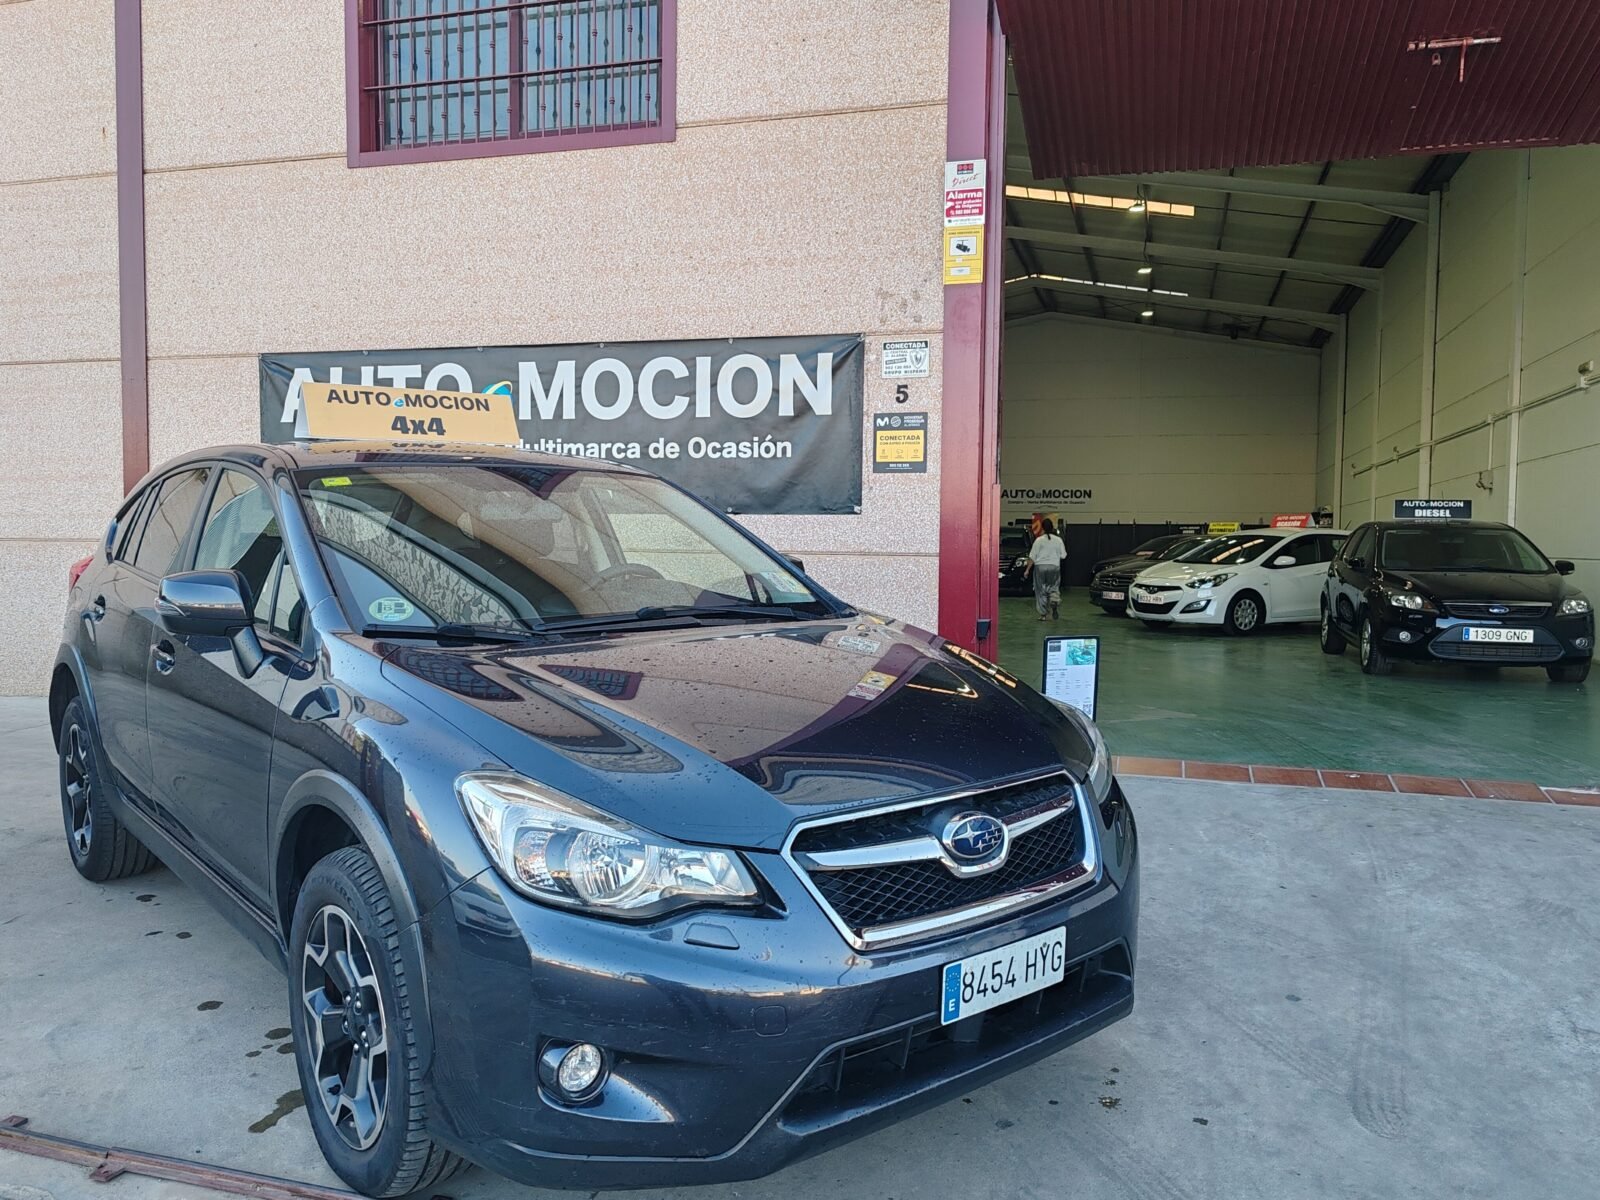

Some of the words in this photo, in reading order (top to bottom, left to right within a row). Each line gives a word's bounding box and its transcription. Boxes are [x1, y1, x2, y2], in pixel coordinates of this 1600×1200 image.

[947, 191, 983, 200] Alarma
[885, 342, 926, 350] CONECTADA
[518, 352, 834, 420] MOCION
[895, 384, 909, 404] 5
[327, 389, 390, 406] AUTO
[404, 394, 490, 412] MOCION
[391, 415, 447, 436] 4x4
[506, 437, 641, 459] ltimarca
[648, 438, 681, 459] de
[688, 435, 793, 459] Ocasión
[1001, 489, 1036, 499] AUTO
[1042, 489, 1092, 499] MOCION
[1414, 509, 1452, 518] DIESEL
[1473, 629, 1502, 640] 1309
[1505, 631, 1528, 641] GNG
[948, 998, 956, 1012] E
[961, 956, 1017, 1004] 8454
[1025, 941, 1063, 983] HYG
